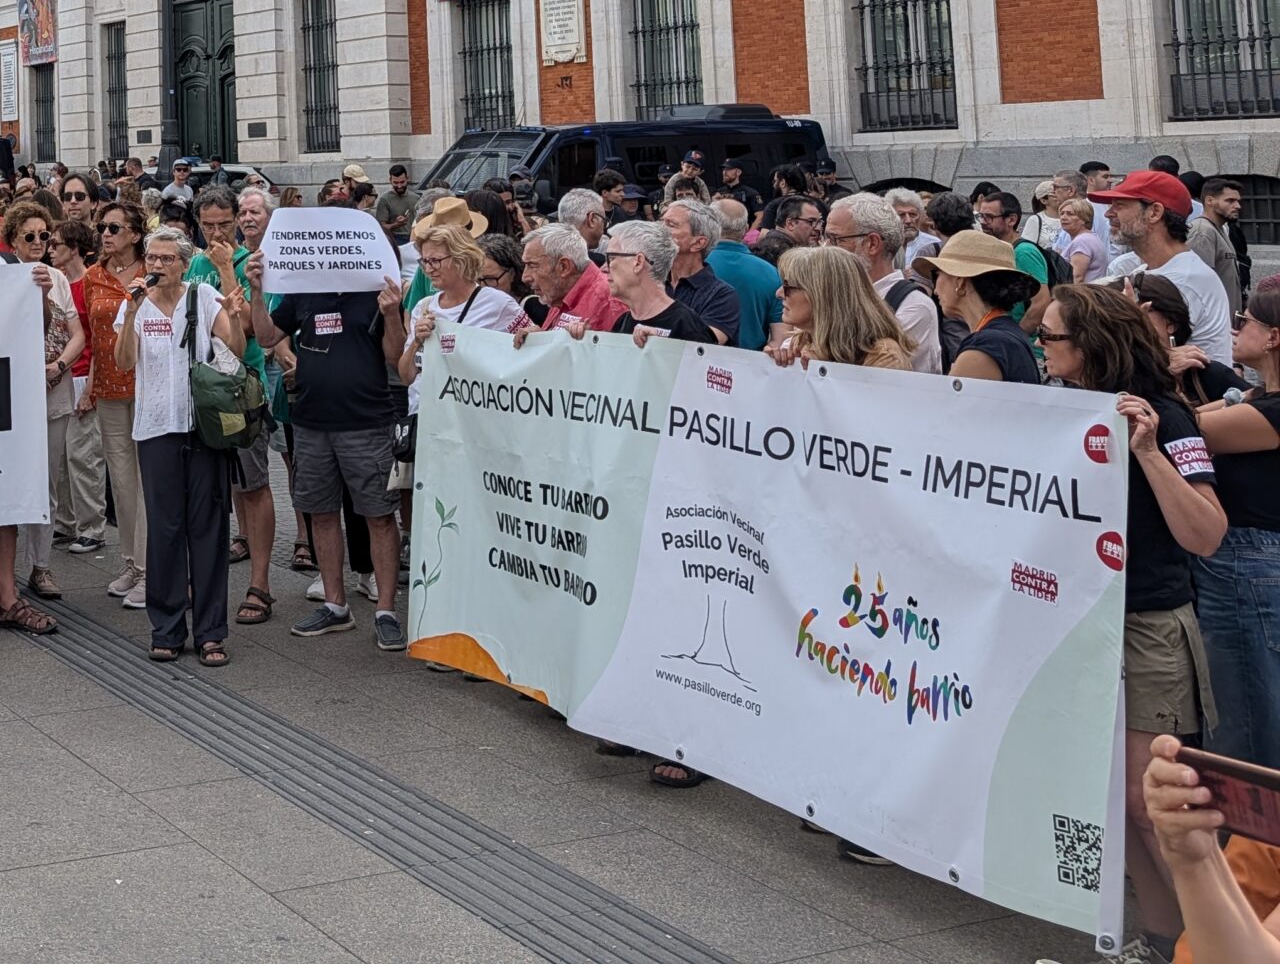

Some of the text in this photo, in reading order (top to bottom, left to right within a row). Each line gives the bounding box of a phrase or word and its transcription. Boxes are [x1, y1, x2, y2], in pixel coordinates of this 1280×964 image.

[272, 230, 376, 241] TENDREMOS MENOS
[279, 245, 365, 256] ZONAS VERDES,
[268, 260, 382, 271] PARQUES Y JARDINES
[707, 372, 732, 389] CONTRA
[708, 365, 732, 378] MADRID
[438, 375, 1102, 523] ASOCIACIÓN VECINAL PASILLO VERDE - IMPERIAL
[1180, 462, 1198, 474] LA
[483, 471, 532, 503] CONOCE
[539, 483, 560, 507] TU
[496, 511, 522, 539] VIVE
[524, 520, 547, 545] TU
[665, 503, 764, 545] Asociación Vecinal
[488, 547, 539, 582] CAMBIA
[539, 564, 560, 588] TU
[661, 529, 770, 574] Pasillo Verde
[682, 559, 754, 594] Imperial
[1012, 572, 1056, 593] CONTRA
[1013, 561, 1057, 583] MADRID
[1012, 582, 1056, 604] LA LIDER
[839, 584, 940, 650] 25 años
[795, 608, 973, 725] haciendo barrio
[655, 669, 762, 716] www.pasilloverde.org
